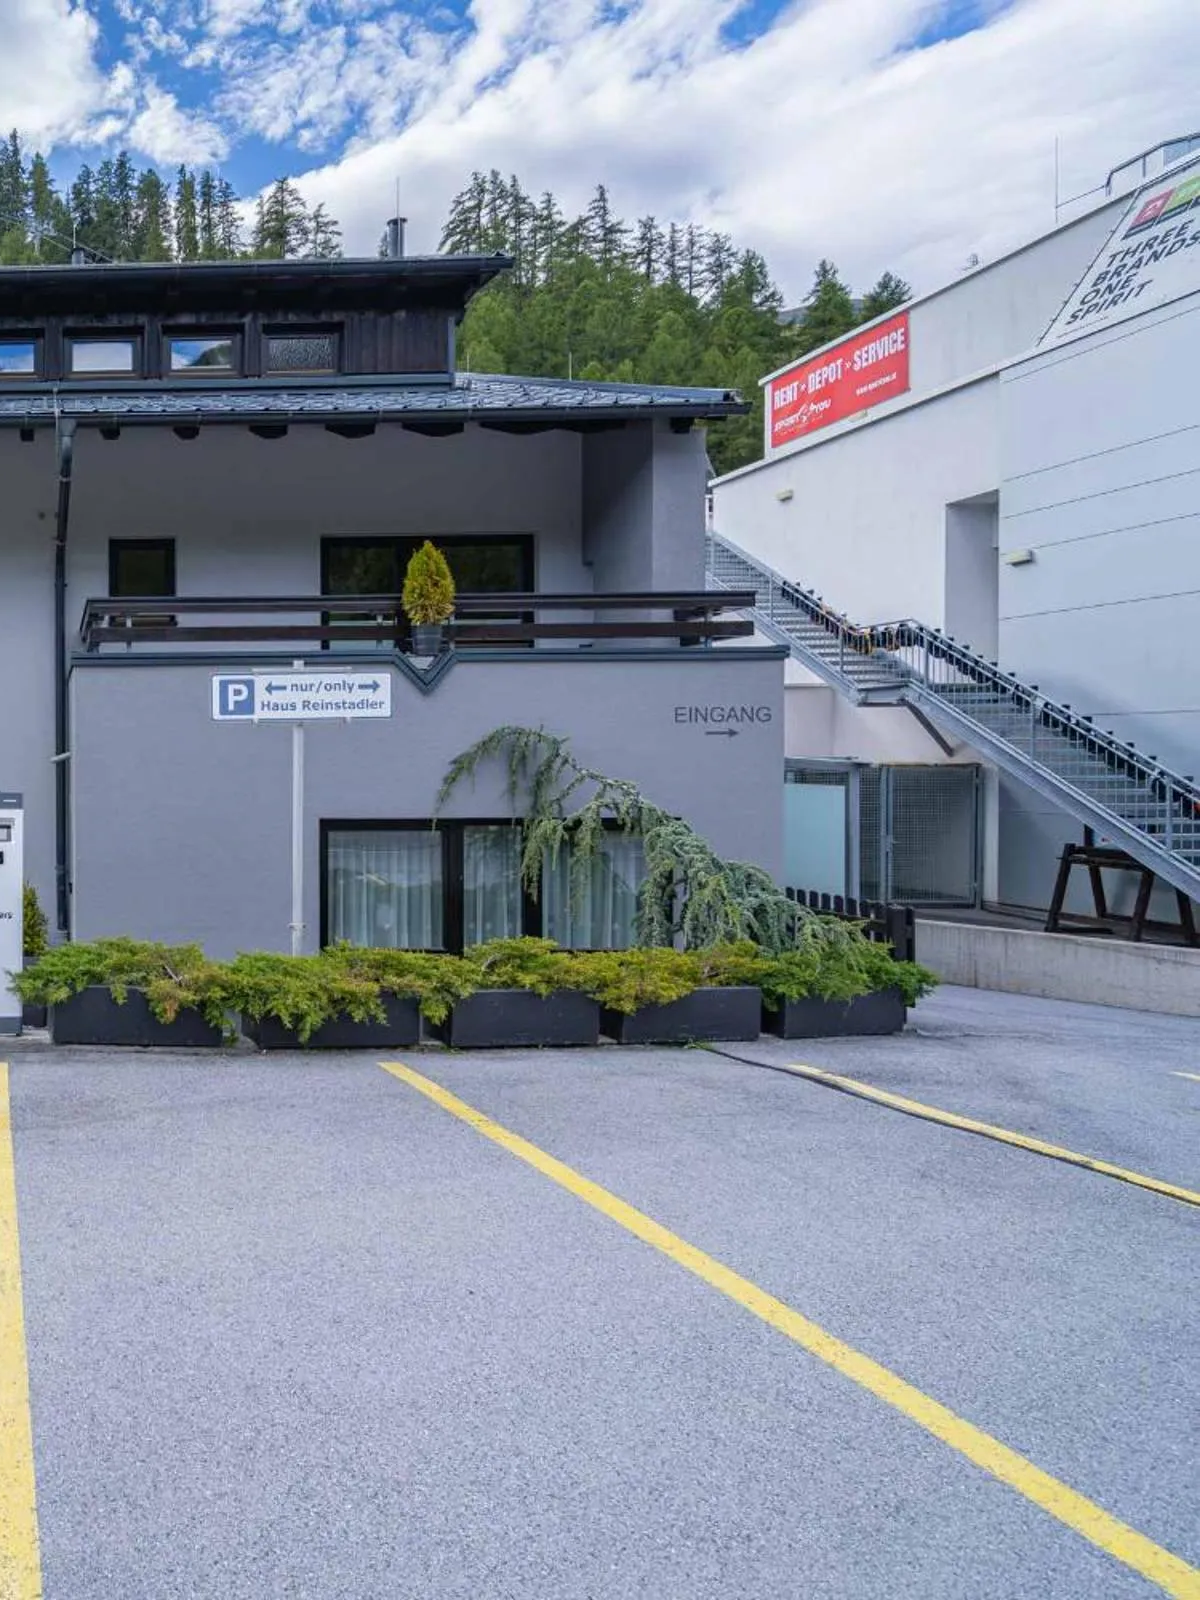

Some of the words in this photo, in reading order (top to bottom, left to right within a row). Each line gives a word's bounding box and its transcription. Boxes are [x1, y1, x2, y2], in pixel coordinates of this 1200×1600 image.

[1107, 219, 1195, 268] THREE
[1065, 279, 1153, 325] SPIRIT
[1079, 271, 1139, 305] ONE
[774, 380, 799, 410] RENT
[808, 359, 843, 394] DEPOT
[853, 327, 905, 371] SERVICE
[228, 684, 249, 711] P
[290, 680, 355, 693] nur/only
[260, 701, 297, 712] Haus
[302, 699, 385, 712] Reinstadler
[674, 706, 772, 723] EINGANG
